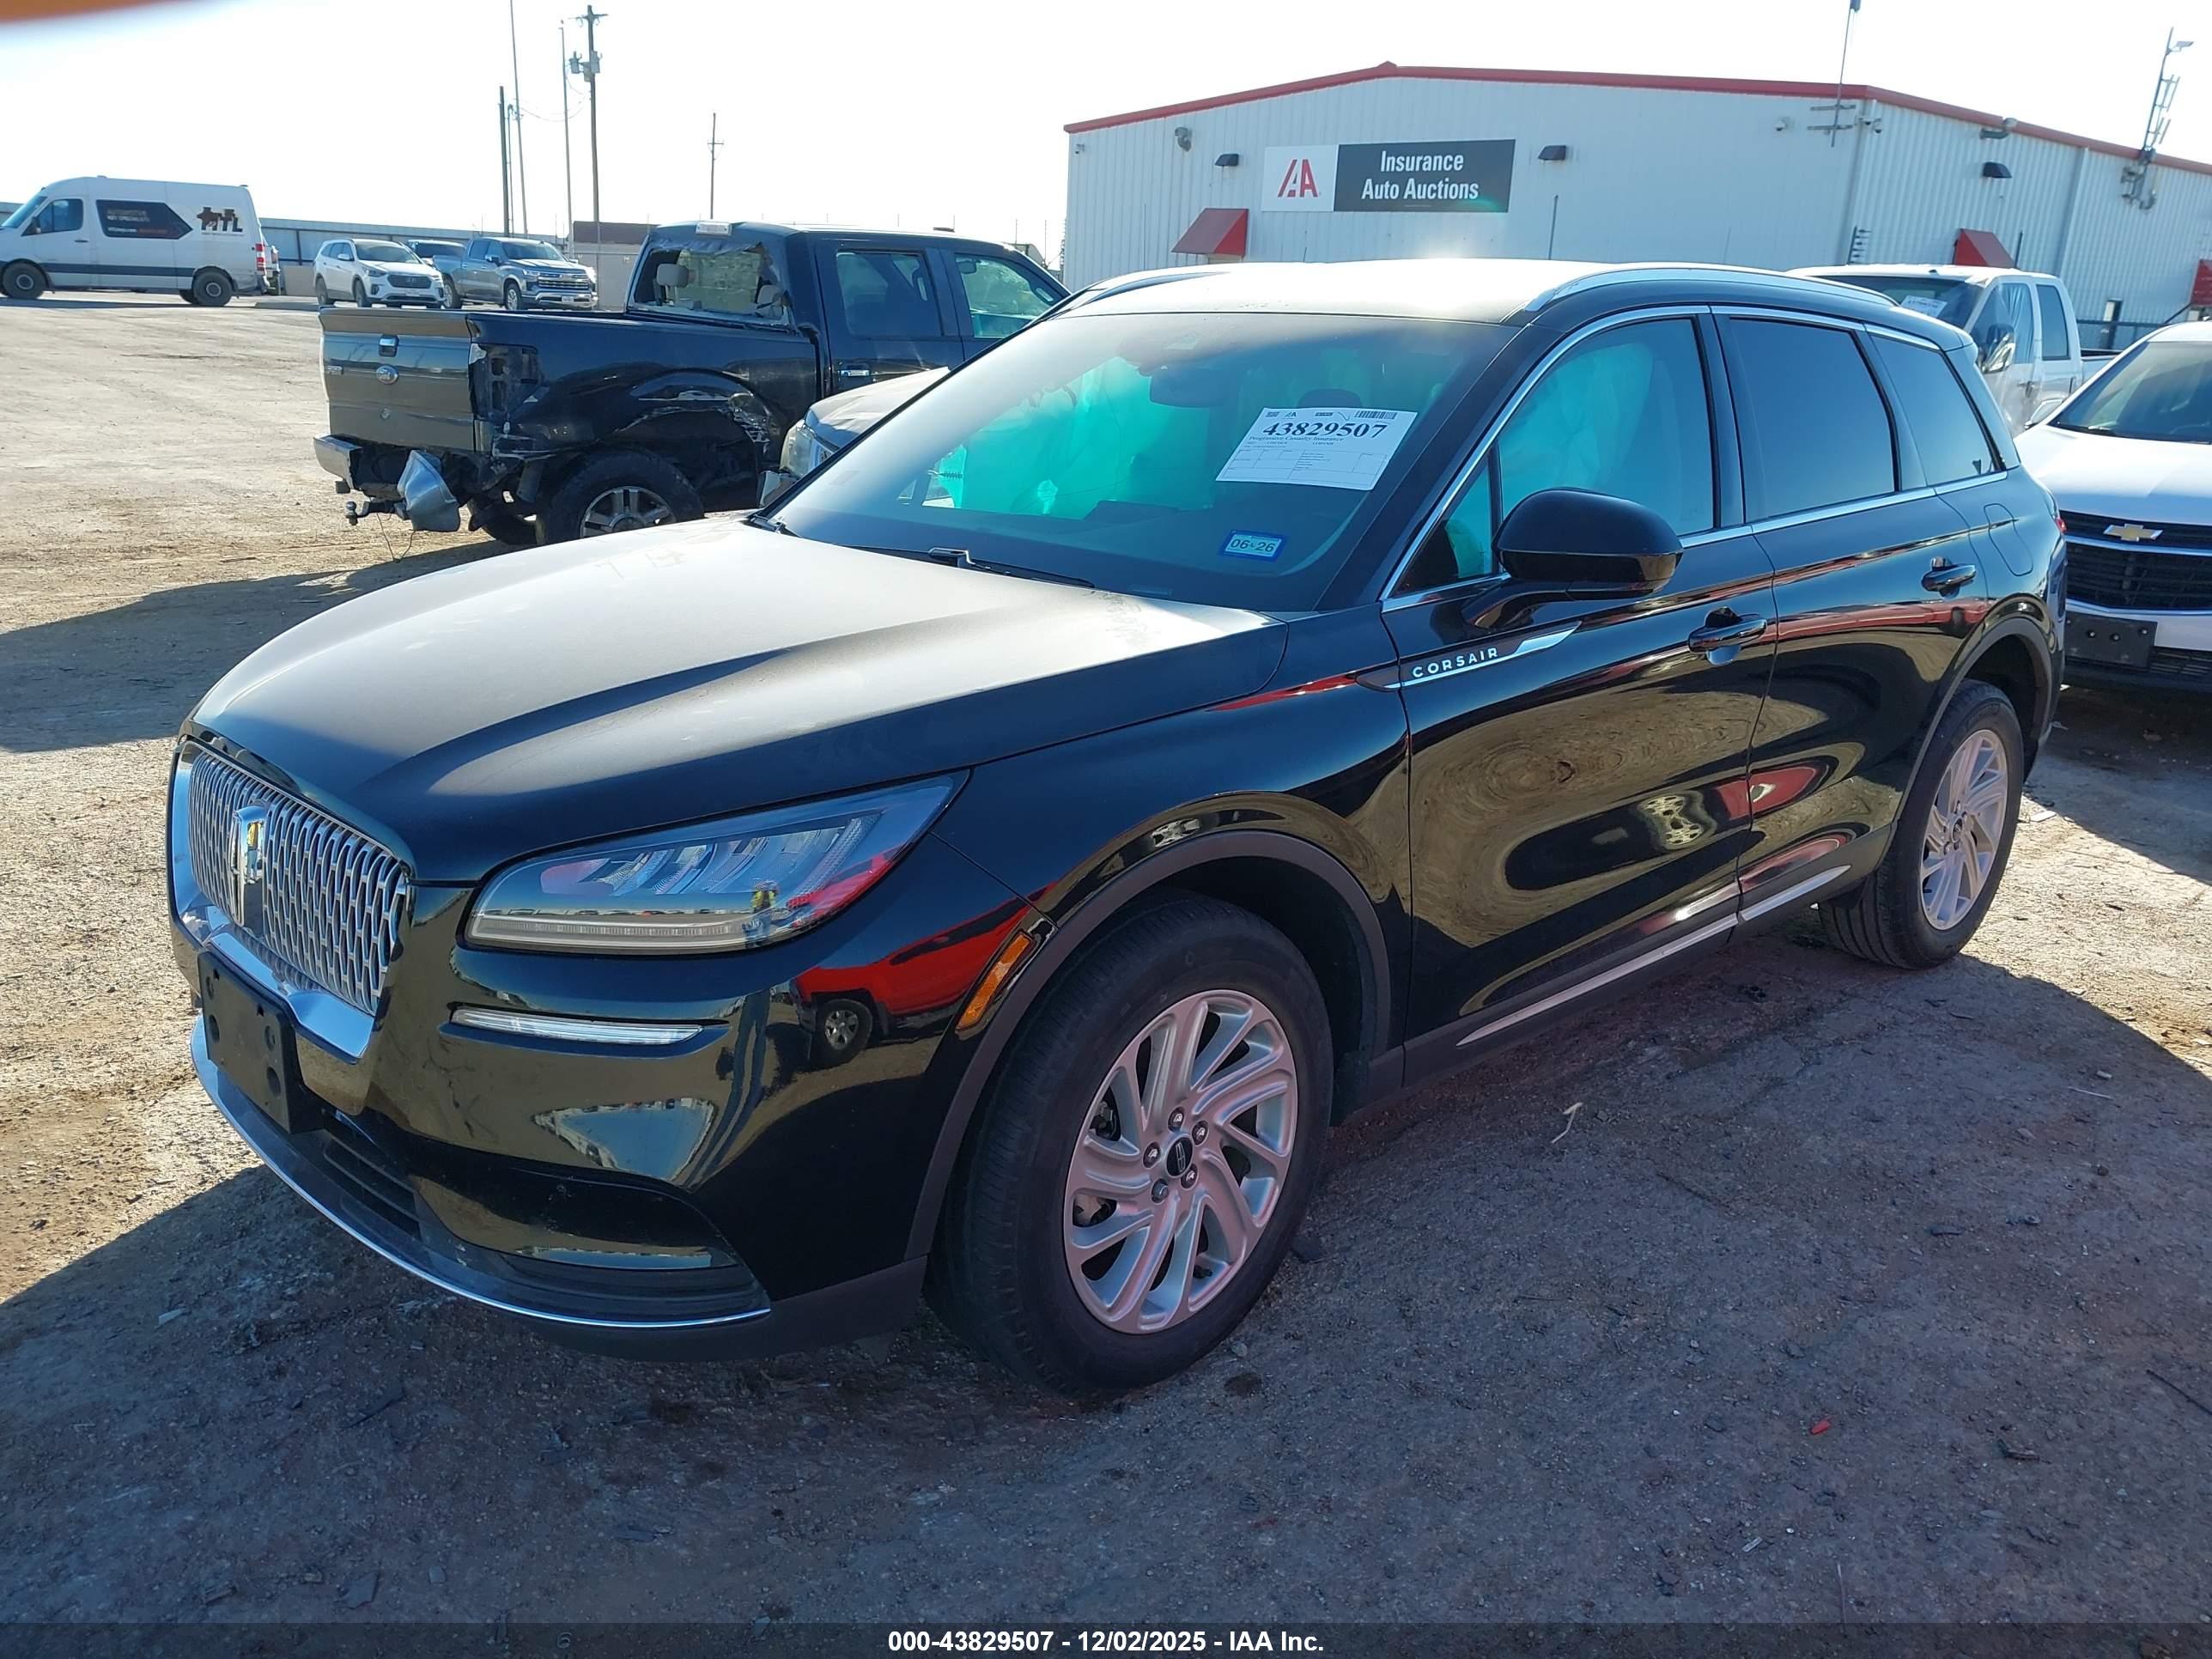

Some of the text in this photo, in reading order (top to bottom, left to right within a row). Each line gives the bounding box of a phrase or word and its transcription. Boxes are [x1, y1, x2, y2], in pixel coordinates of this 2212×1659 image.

[1380, 151, 1464, 173] Insurance
[1361, 178, 1480, 200] Auto Auctions
[1263, 422, 1388, 438] 43829507
[1412, 647, 1498, 678] CORSAIR
